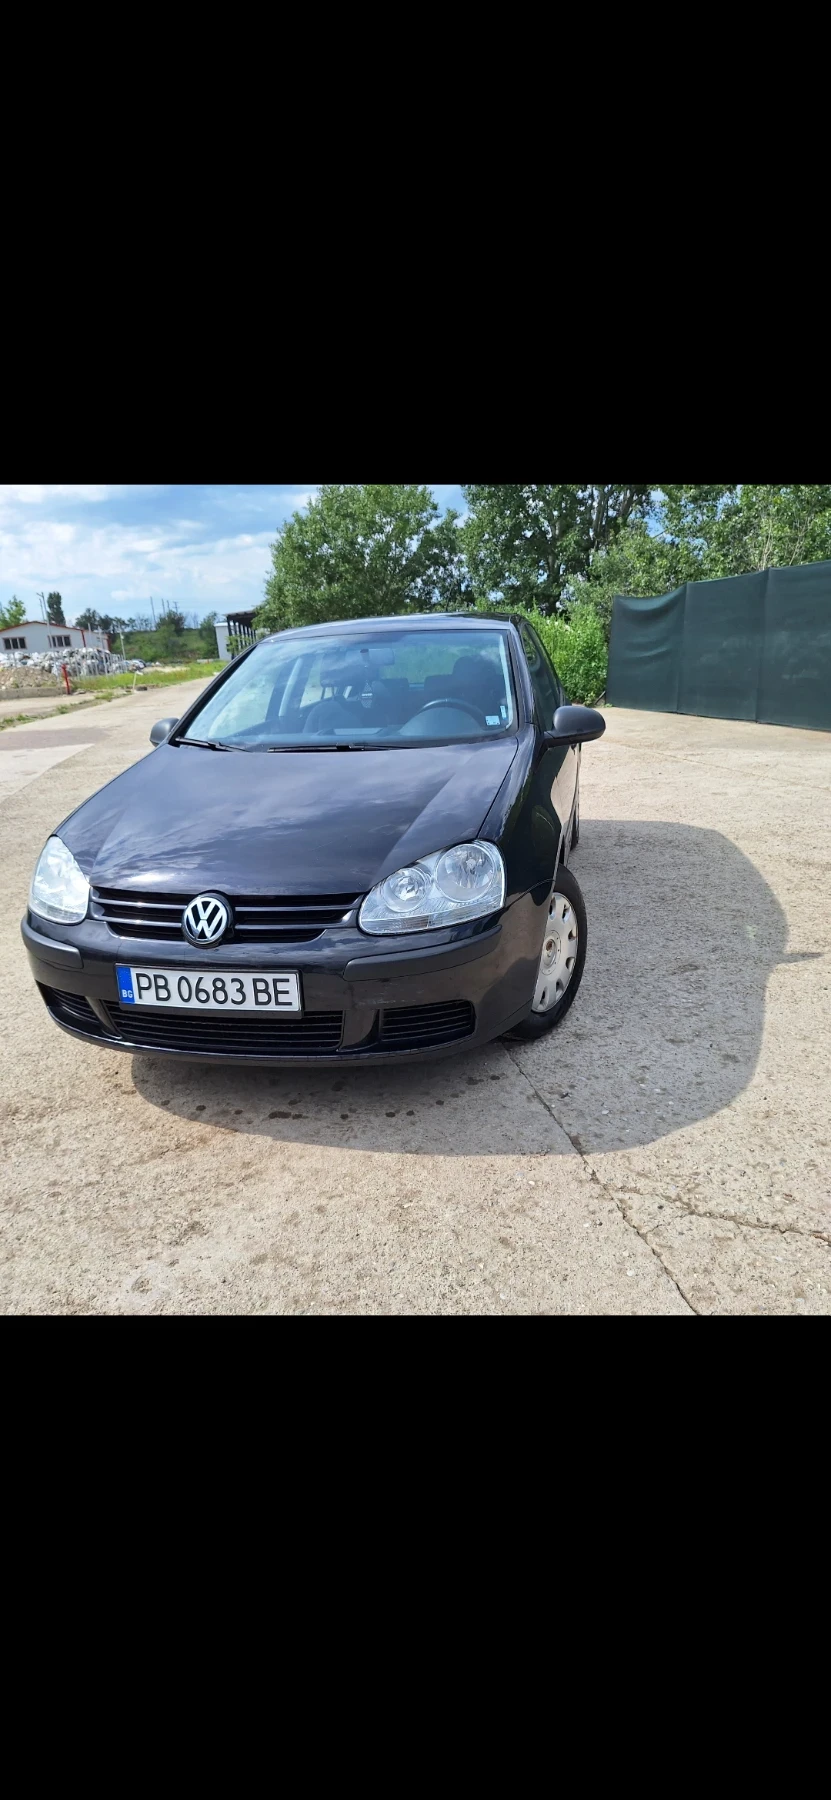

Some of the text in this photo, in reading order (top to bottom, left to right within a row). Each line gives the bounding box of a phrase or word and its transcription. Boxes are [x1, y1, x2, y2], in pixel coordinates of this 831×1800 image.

[185, 897, 228, 944] VW
[122, 989, 133, 998] BG
[135, 973, 292, 1006] PB 0683 BE
